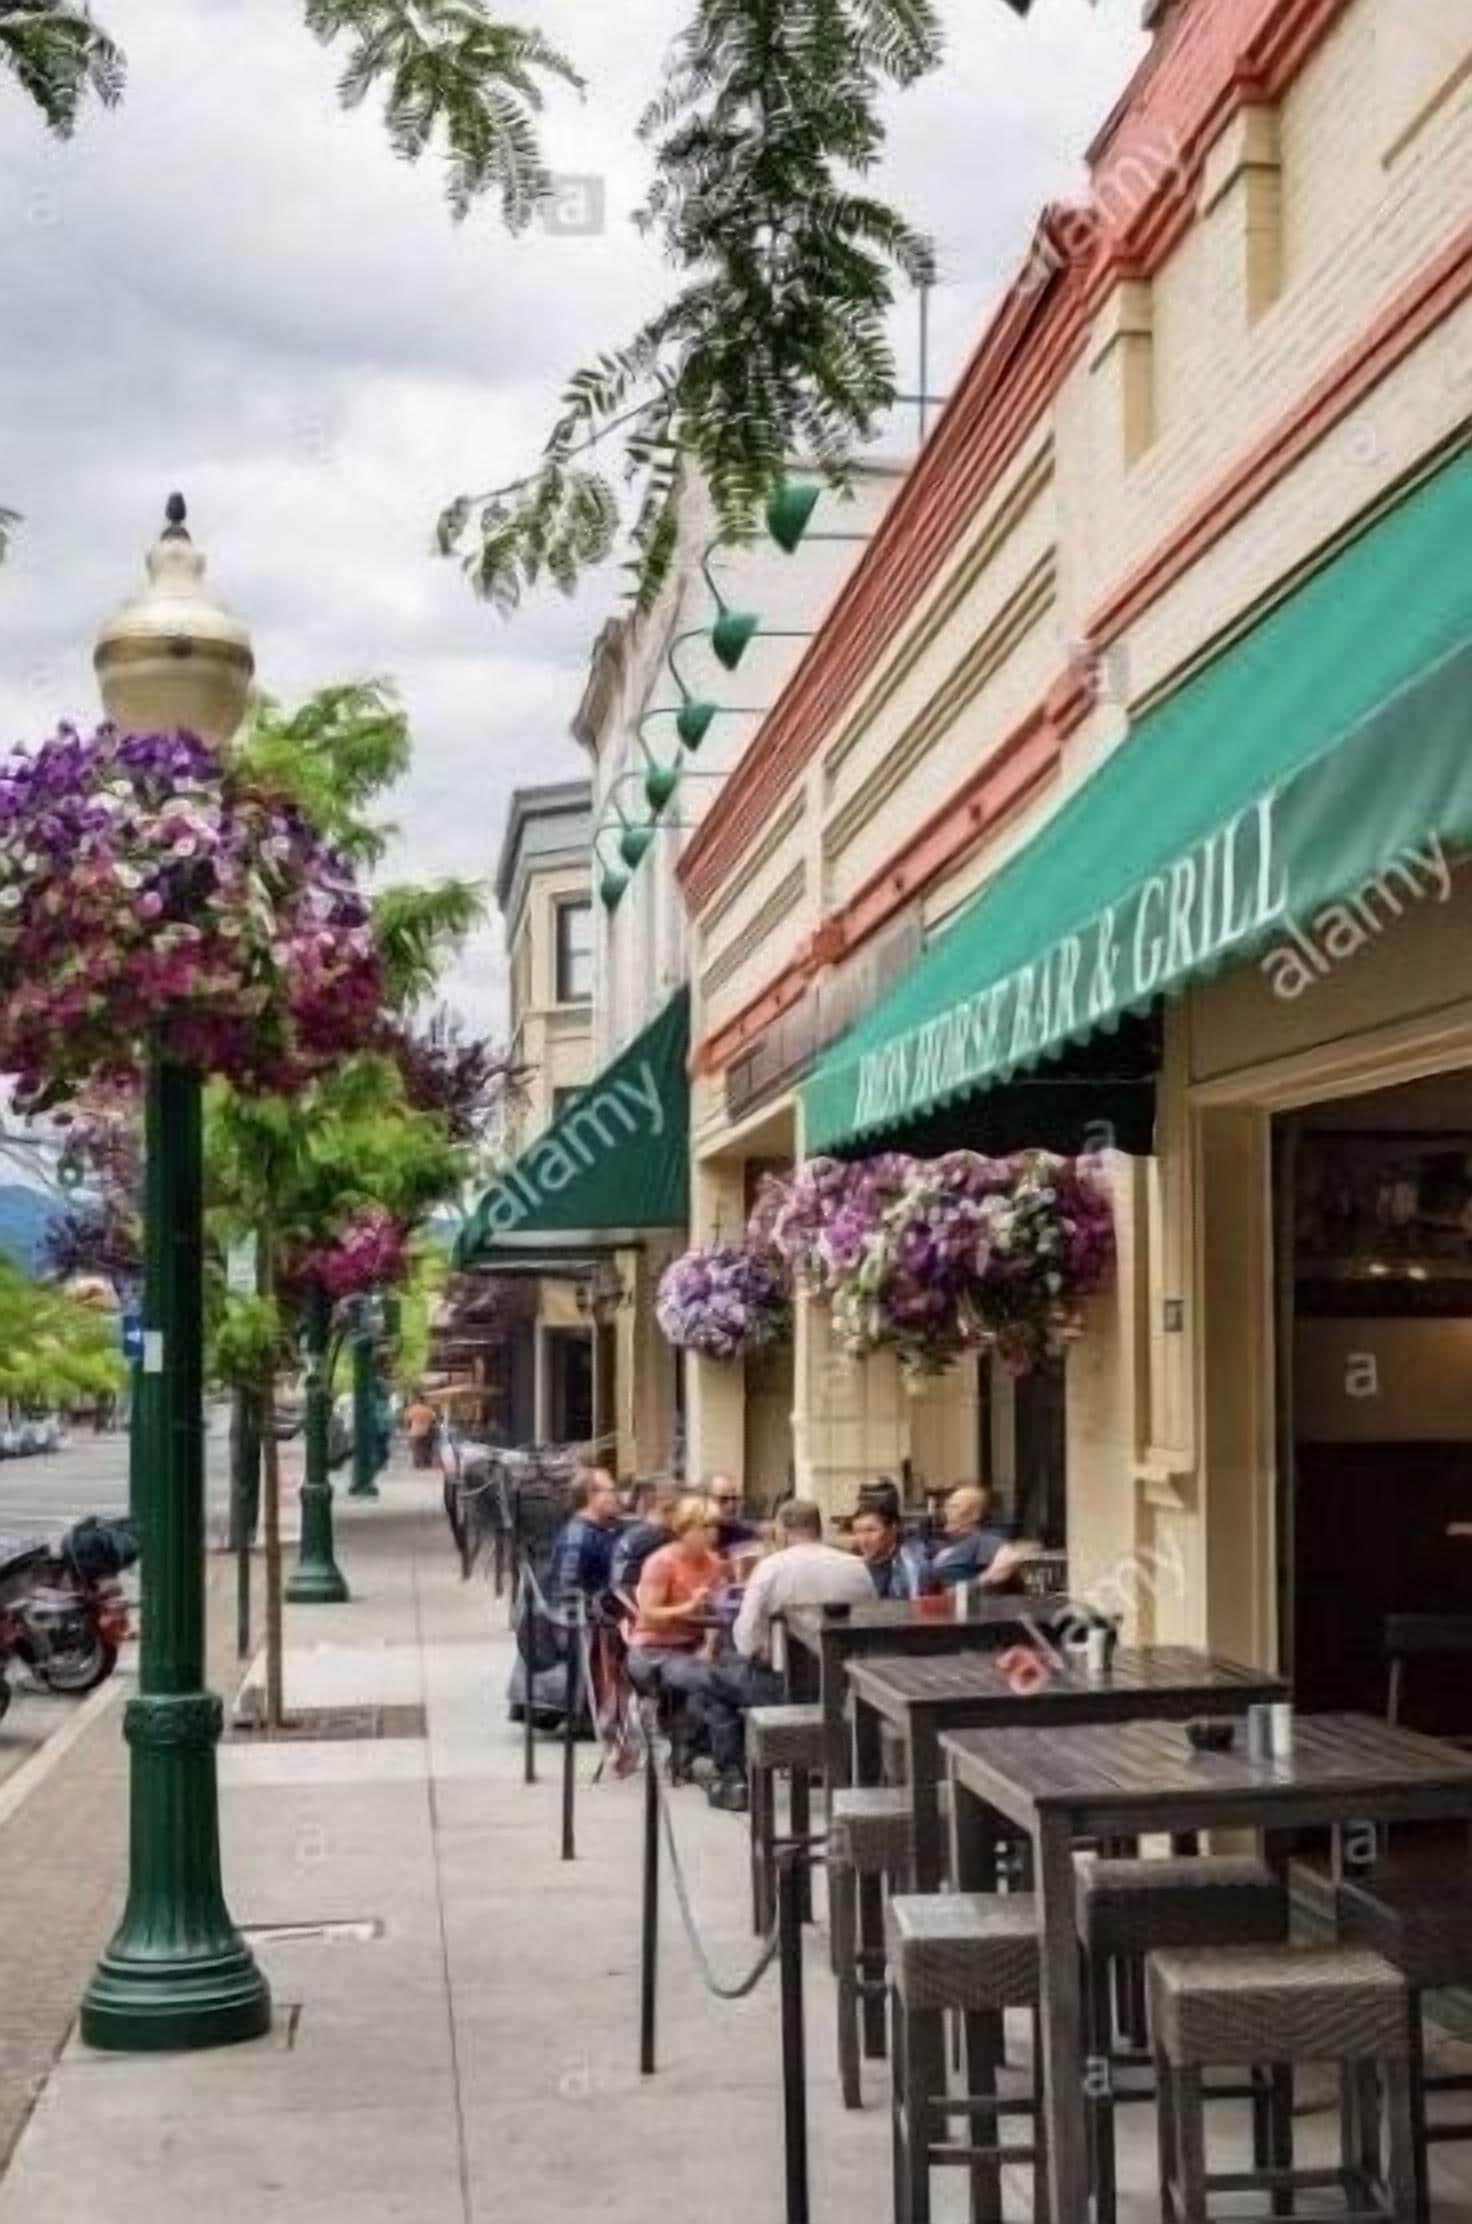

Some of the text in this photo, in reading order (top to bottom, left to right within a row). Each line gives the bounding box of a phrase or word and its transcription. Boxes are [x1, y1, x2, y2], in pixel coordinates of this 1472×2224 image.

[1008, 935, 1081, 1064] BAR
[1088, 905, 1120, 1018] &
[1132, 785, 1289, 995] GRILL
